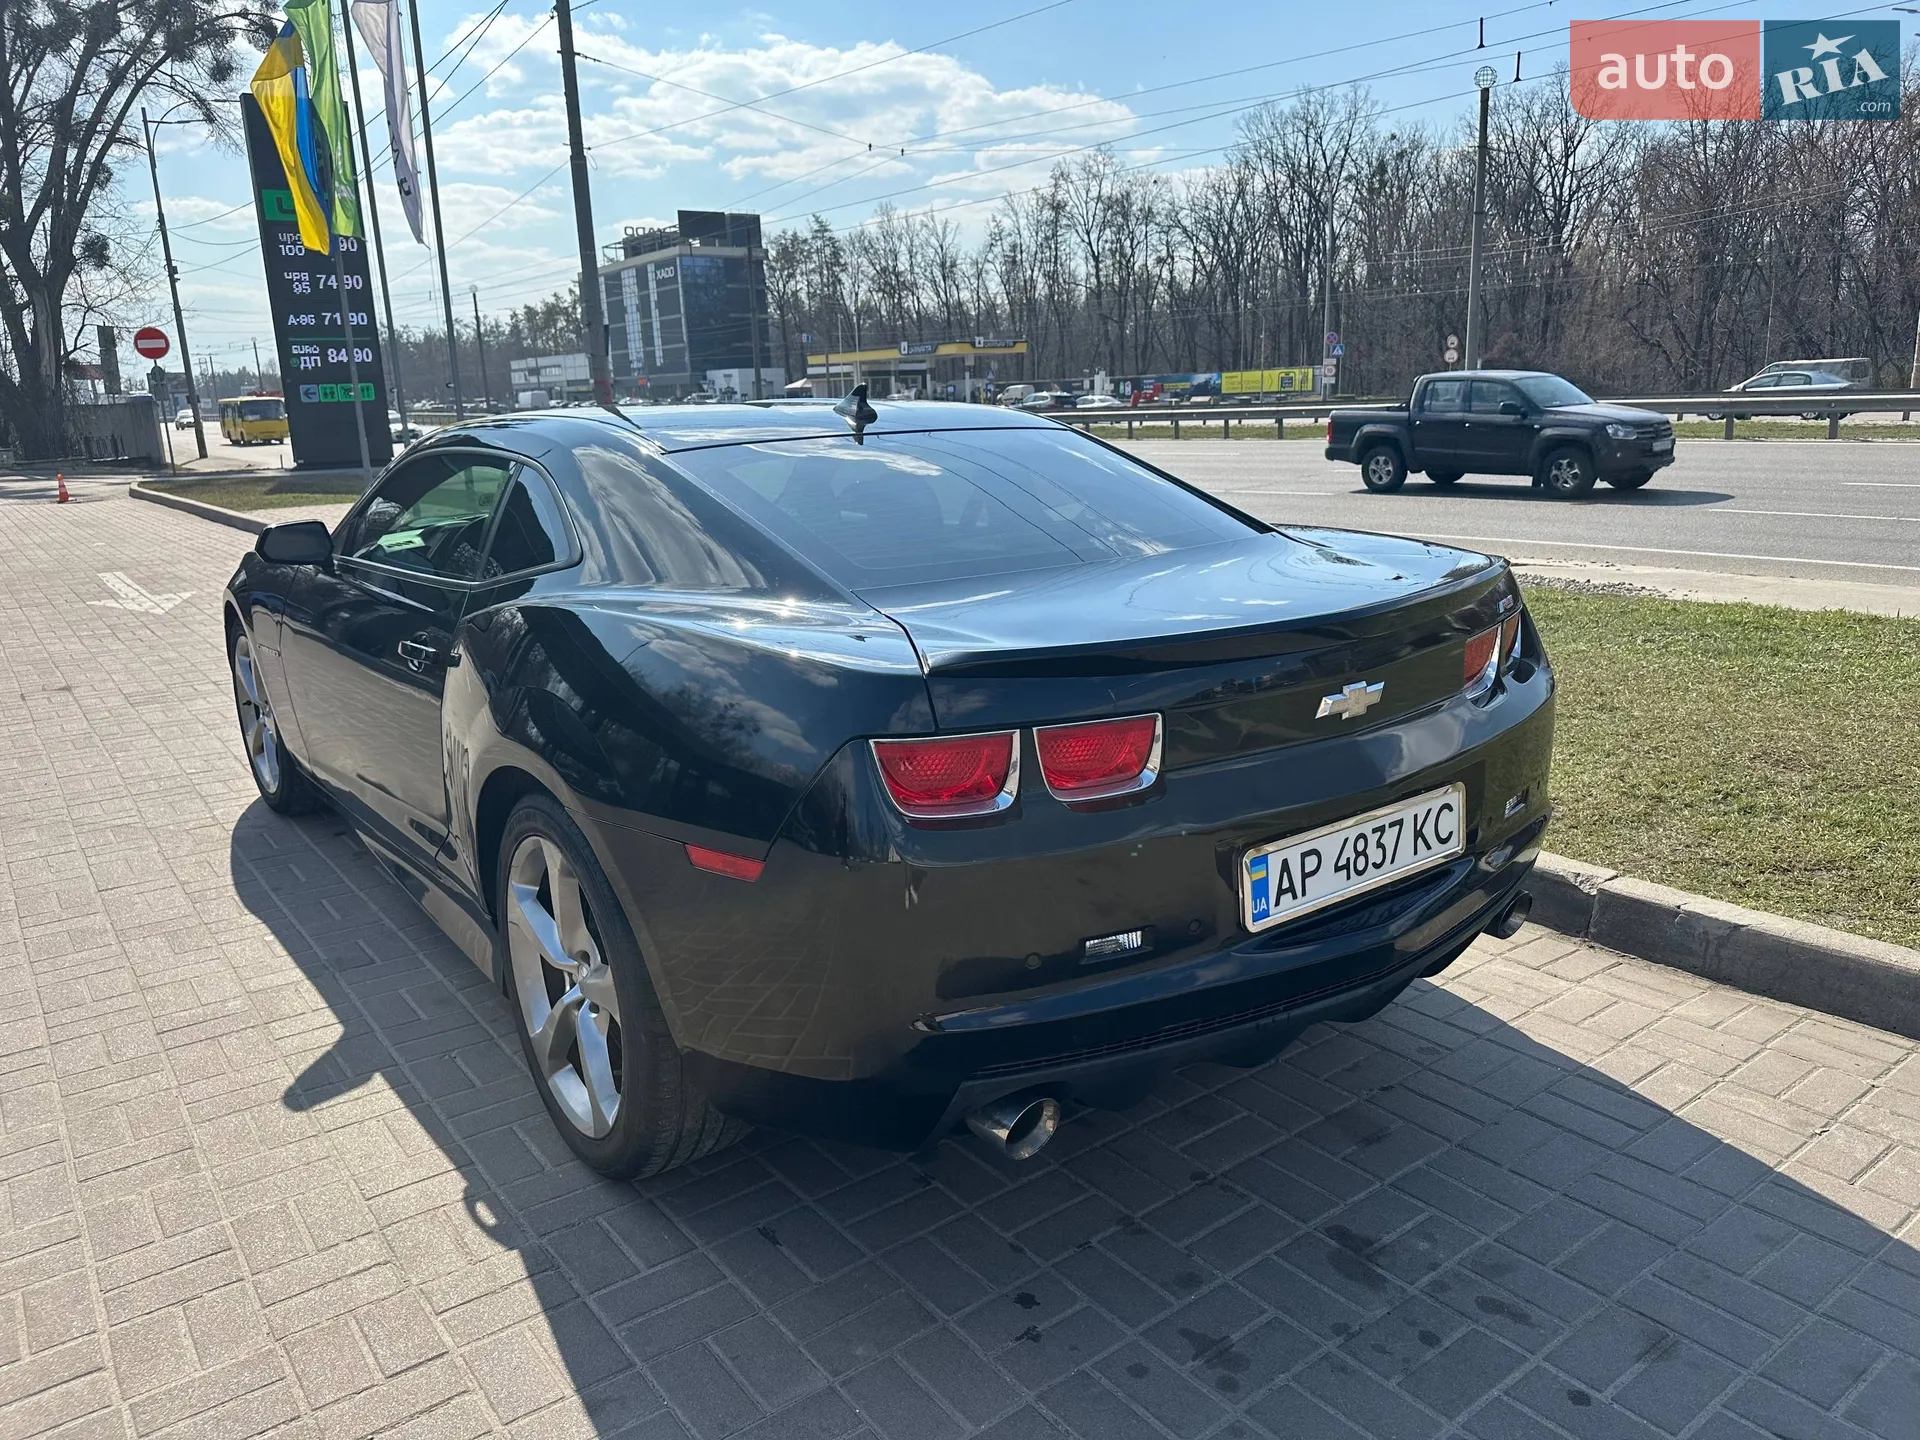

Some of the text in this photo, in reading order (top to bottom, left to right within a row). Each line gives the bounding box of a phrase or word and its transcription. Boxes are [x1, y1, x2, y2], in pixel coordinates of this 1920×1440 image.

[279, 245, 305, 256] 100
[656, 266, 675, 280] XADO
[292, 282, 311, 294] 95
[1273, 802, 1454, 908] AP 4837 KC
[1252, 896, 1268, 914] UA
